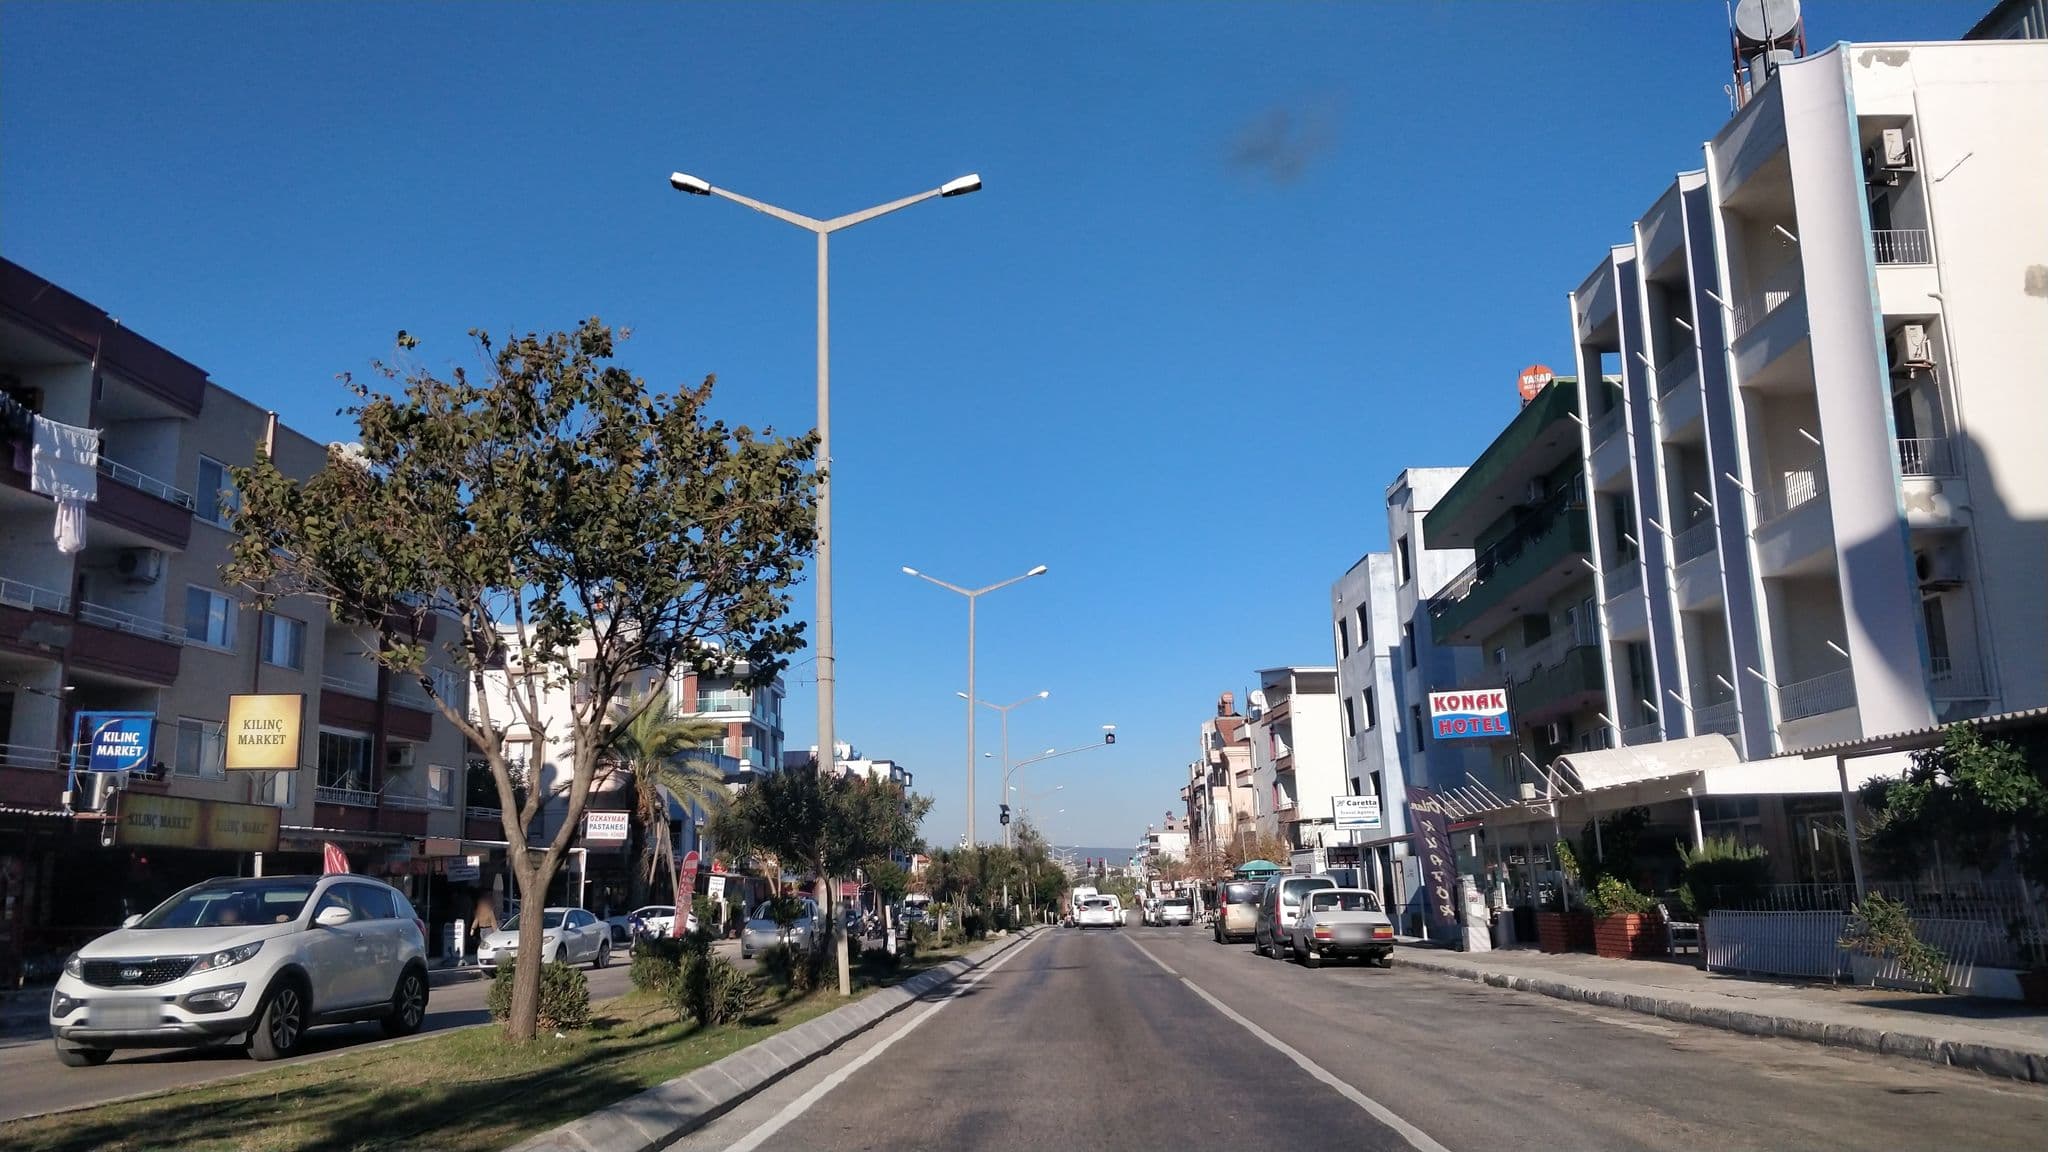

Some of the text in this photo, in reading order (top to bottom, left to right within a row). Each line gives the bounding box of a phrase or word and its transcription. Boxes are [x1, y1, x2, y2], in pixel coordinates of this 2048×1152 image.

[1434, 694, 1504, 712] KONAK
[243, 719, 283, 733] KILINÇ
[1439, 716, 1505, 736] HOTEL
[103, 731, 140, 746] KILINÇ
[238, 734, 286, 745] MARKET
[96, 745, 143, 757] MARKET
[160, 816, 192, 828] MARKET
